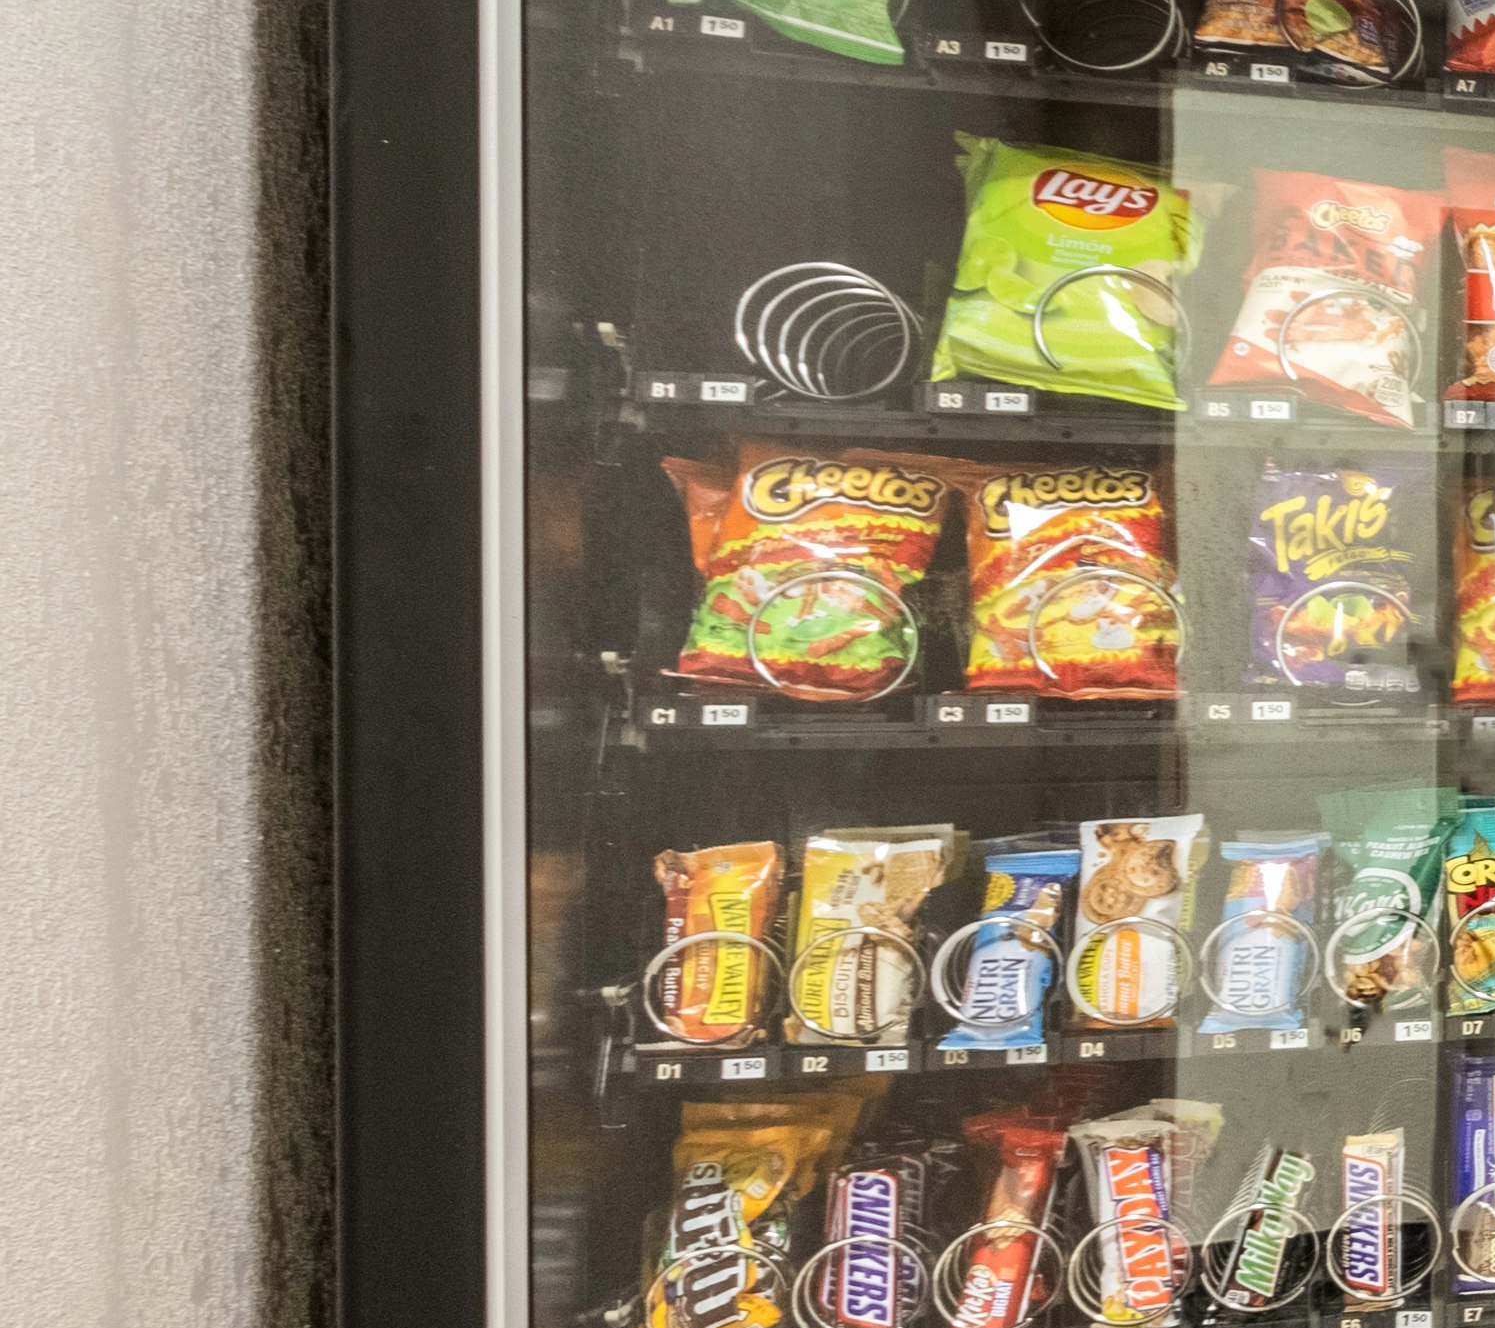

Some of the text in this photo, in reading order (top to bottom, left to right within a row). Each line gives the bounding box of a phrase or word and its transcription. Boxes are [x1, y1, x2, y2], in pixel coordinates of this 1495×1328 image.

[650, 17, 674, 31] A1
[1206, 62, 1229, 76] A5
[1456, 79, 1477, 93] A7
[1036, 171, 1154, 216] Lay's
[1312, 201, 1391, 233] Cheetos
[651, 381, 677, 399] B1
[938, 392, 963, 409] B3
[1455, 409, 1477, 425] B7
[752, 462, 934, 515] Cheetos
[982, 471, 1146, 535] Cheetos
[1260, 487, 1390, 574] Takis
[651, 707, 677, 724] C1
[938, 705, 964, 723] C3
[1208, 704, 1231, 720] C5
[663, 966, 682, 1009] Butter
[834, 946, 858, 1019] BISCUITS
[858, 938, 876, 1031] Almond Butter
[971, 957, 1000, 1021] NUTRI
[998, 956, 1027, 1021] GRAIN
[1228, 946, 1252, 1009] NUTRI
[1252, 944, 1276, 1009] GRAIN
[718, 961, 746, 1022] VALLEY
[1462, 1020, 1484, 1035] D7
[1079, 1042, 1105, 1058] D4
[656, 1064, 682, 1080] D1
[802, 1056, 828, 1073] D2
[1106, 1146, 1172, 1312] PAYDAY
[1463, 1307, 1483, 1322] E7
